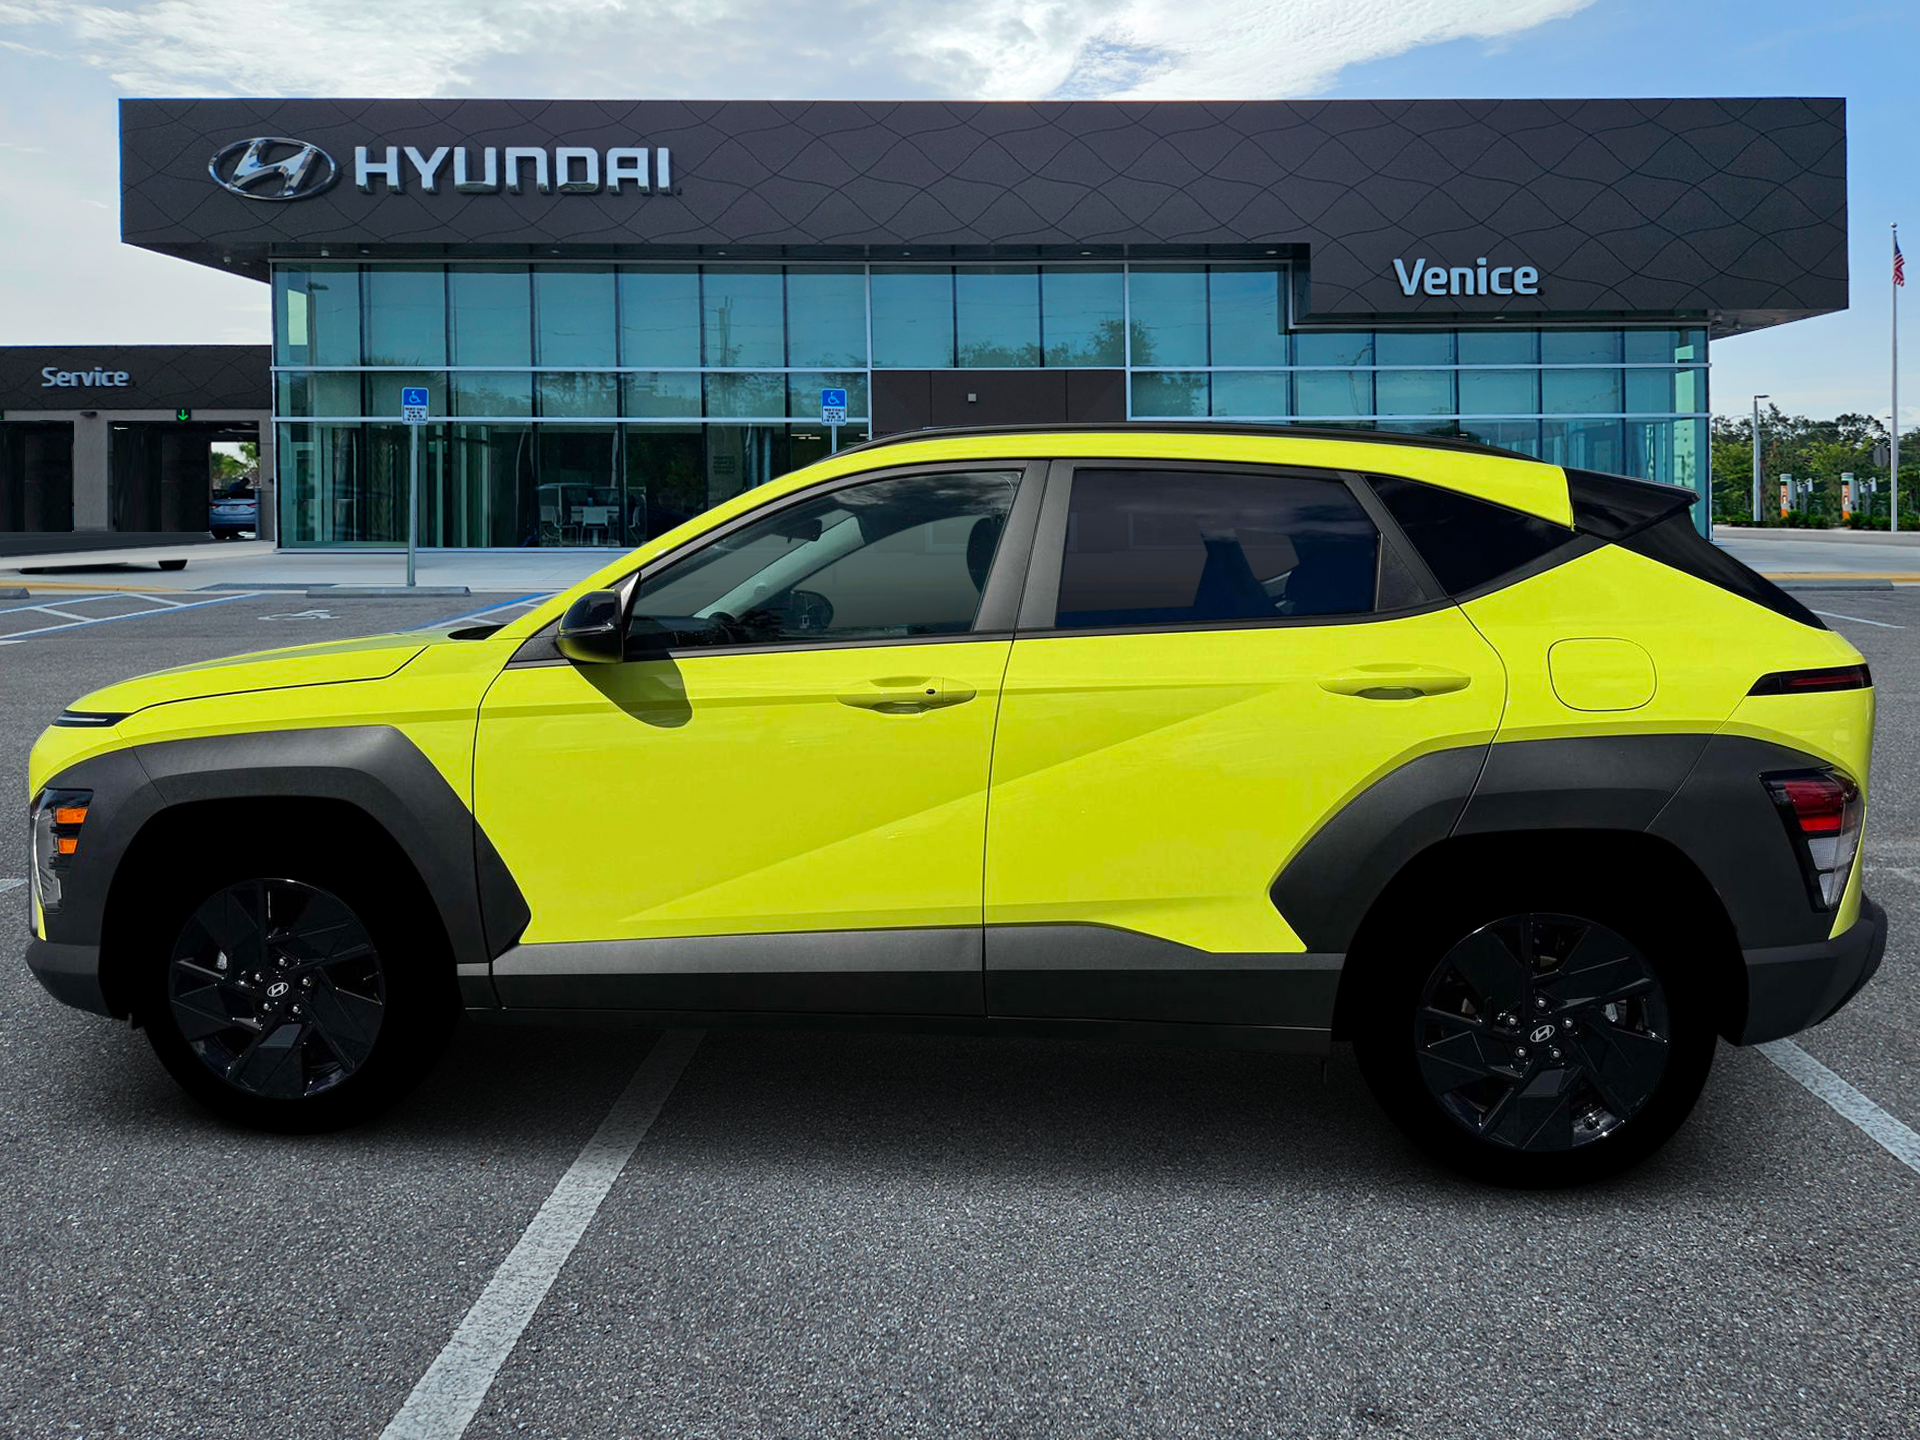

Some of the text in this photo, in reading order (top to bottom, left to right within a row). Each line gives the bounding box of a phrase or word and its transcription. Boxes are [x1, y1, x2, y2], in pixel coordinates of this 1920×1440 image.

[354, 146, 672, 195] HYUNDAI
[1393, 257, 1539, 296] Venice
[41, 366, 130, 387] Service
